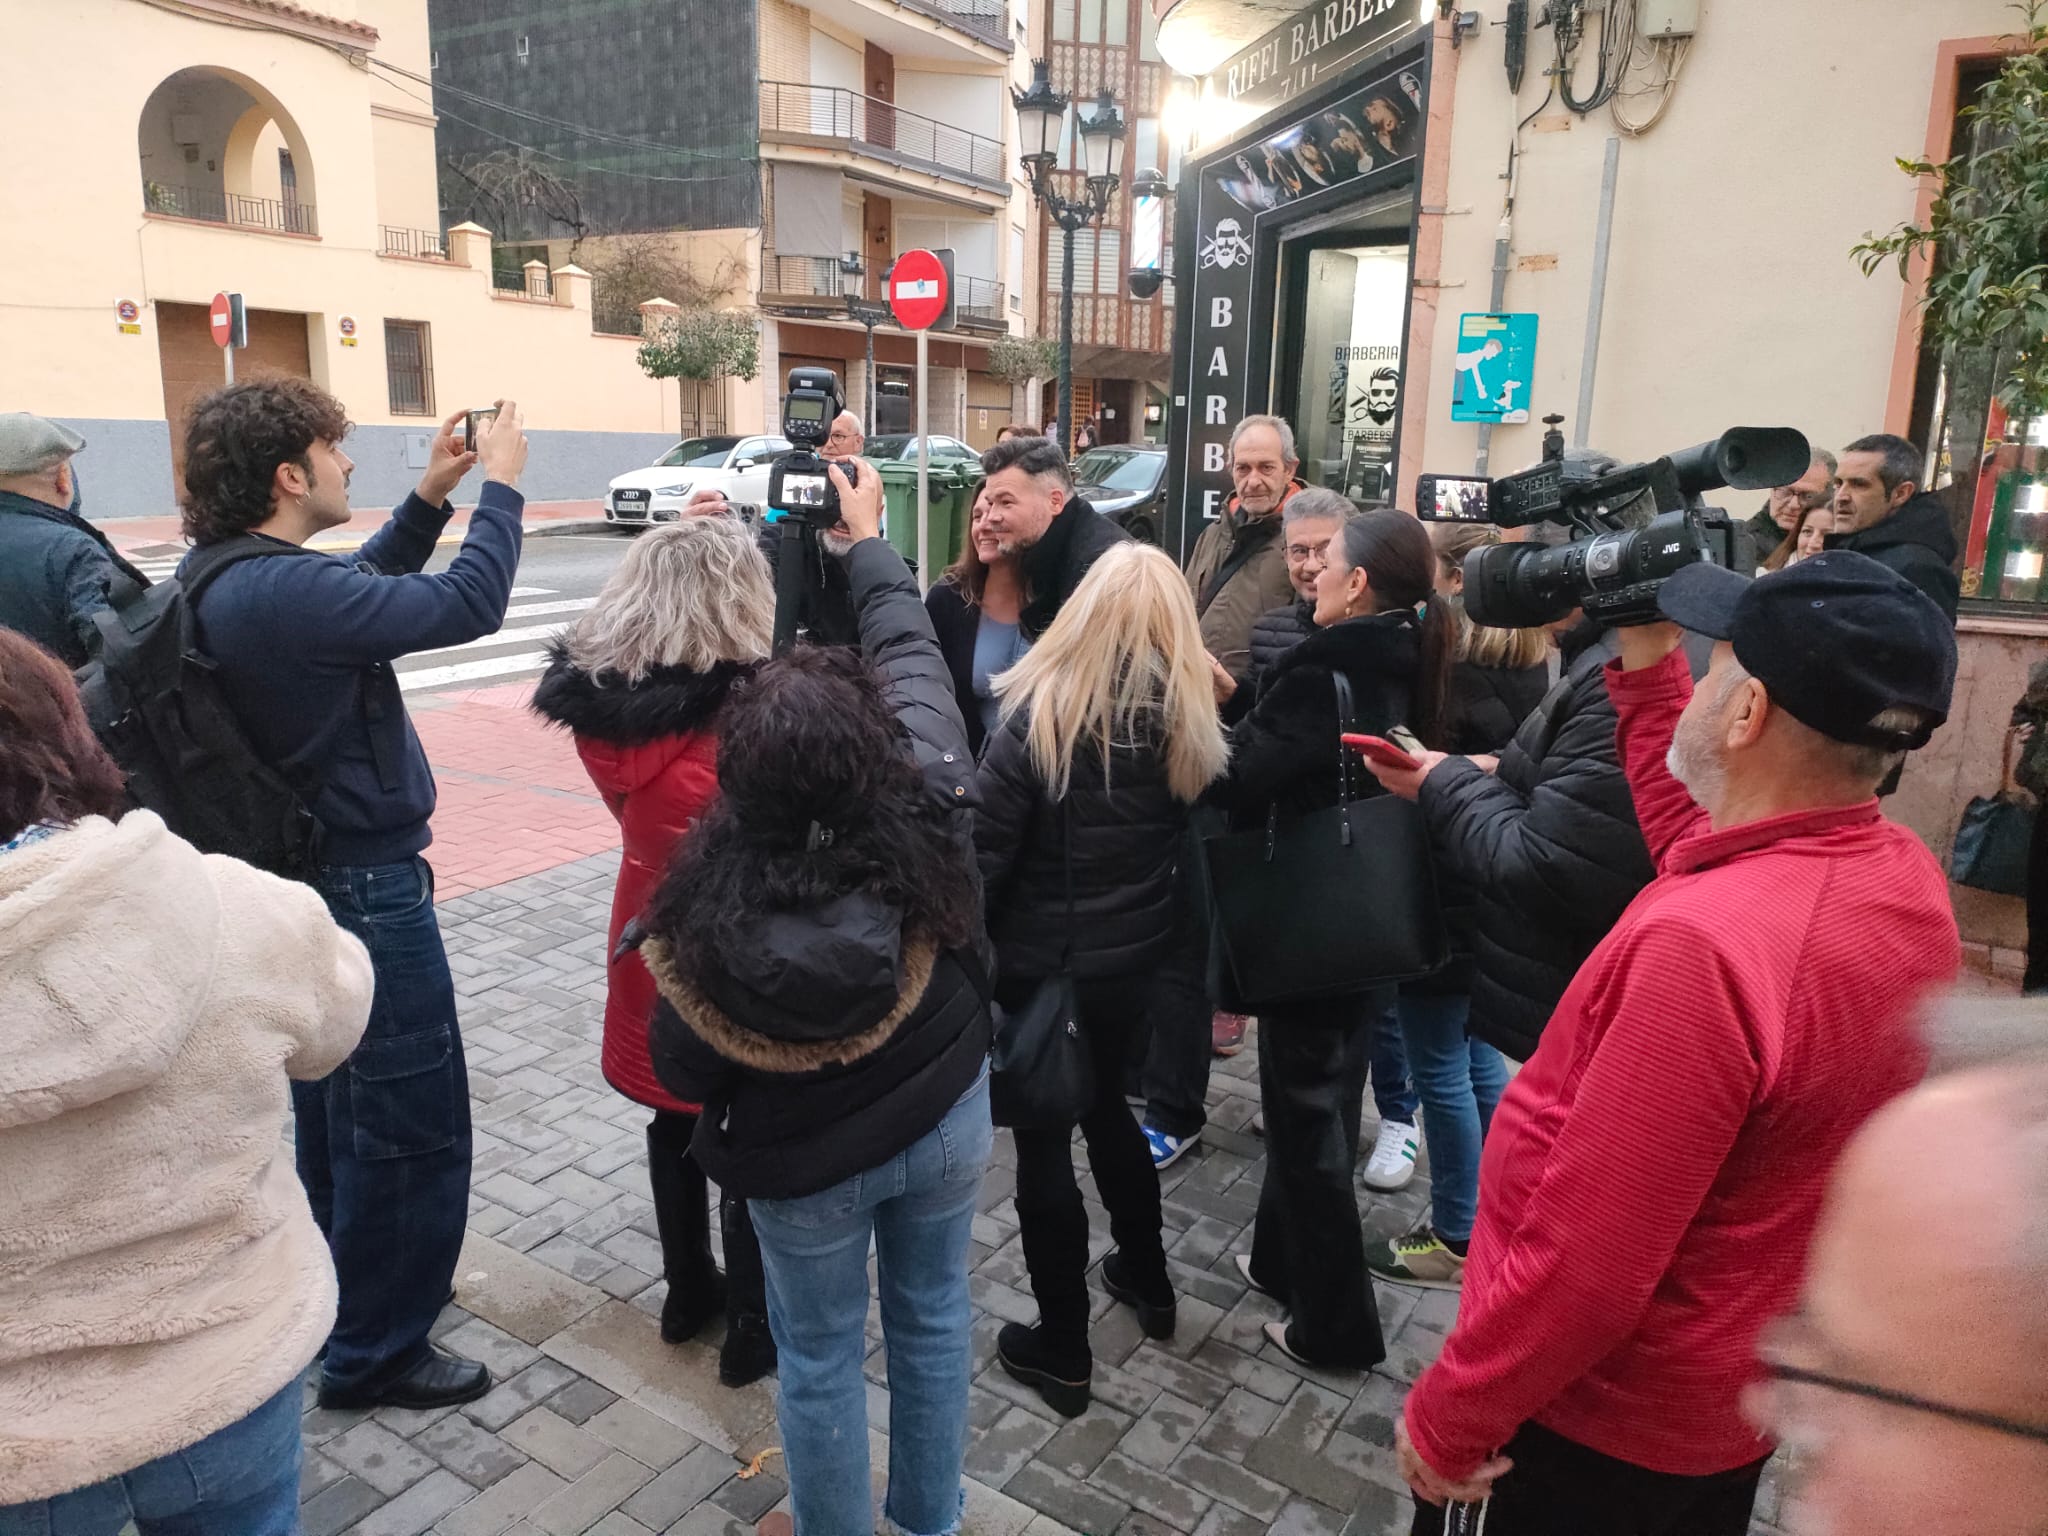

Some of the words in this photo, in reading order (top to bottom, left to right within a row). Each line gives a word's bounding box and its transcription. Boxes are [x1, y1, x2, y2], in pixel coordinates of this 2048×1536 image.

[1227, 38, 1281, 100] RIFFI
[1335, 346, 1399, 361] BARBERIA
[1662, 542, 1681, 554] JVC
